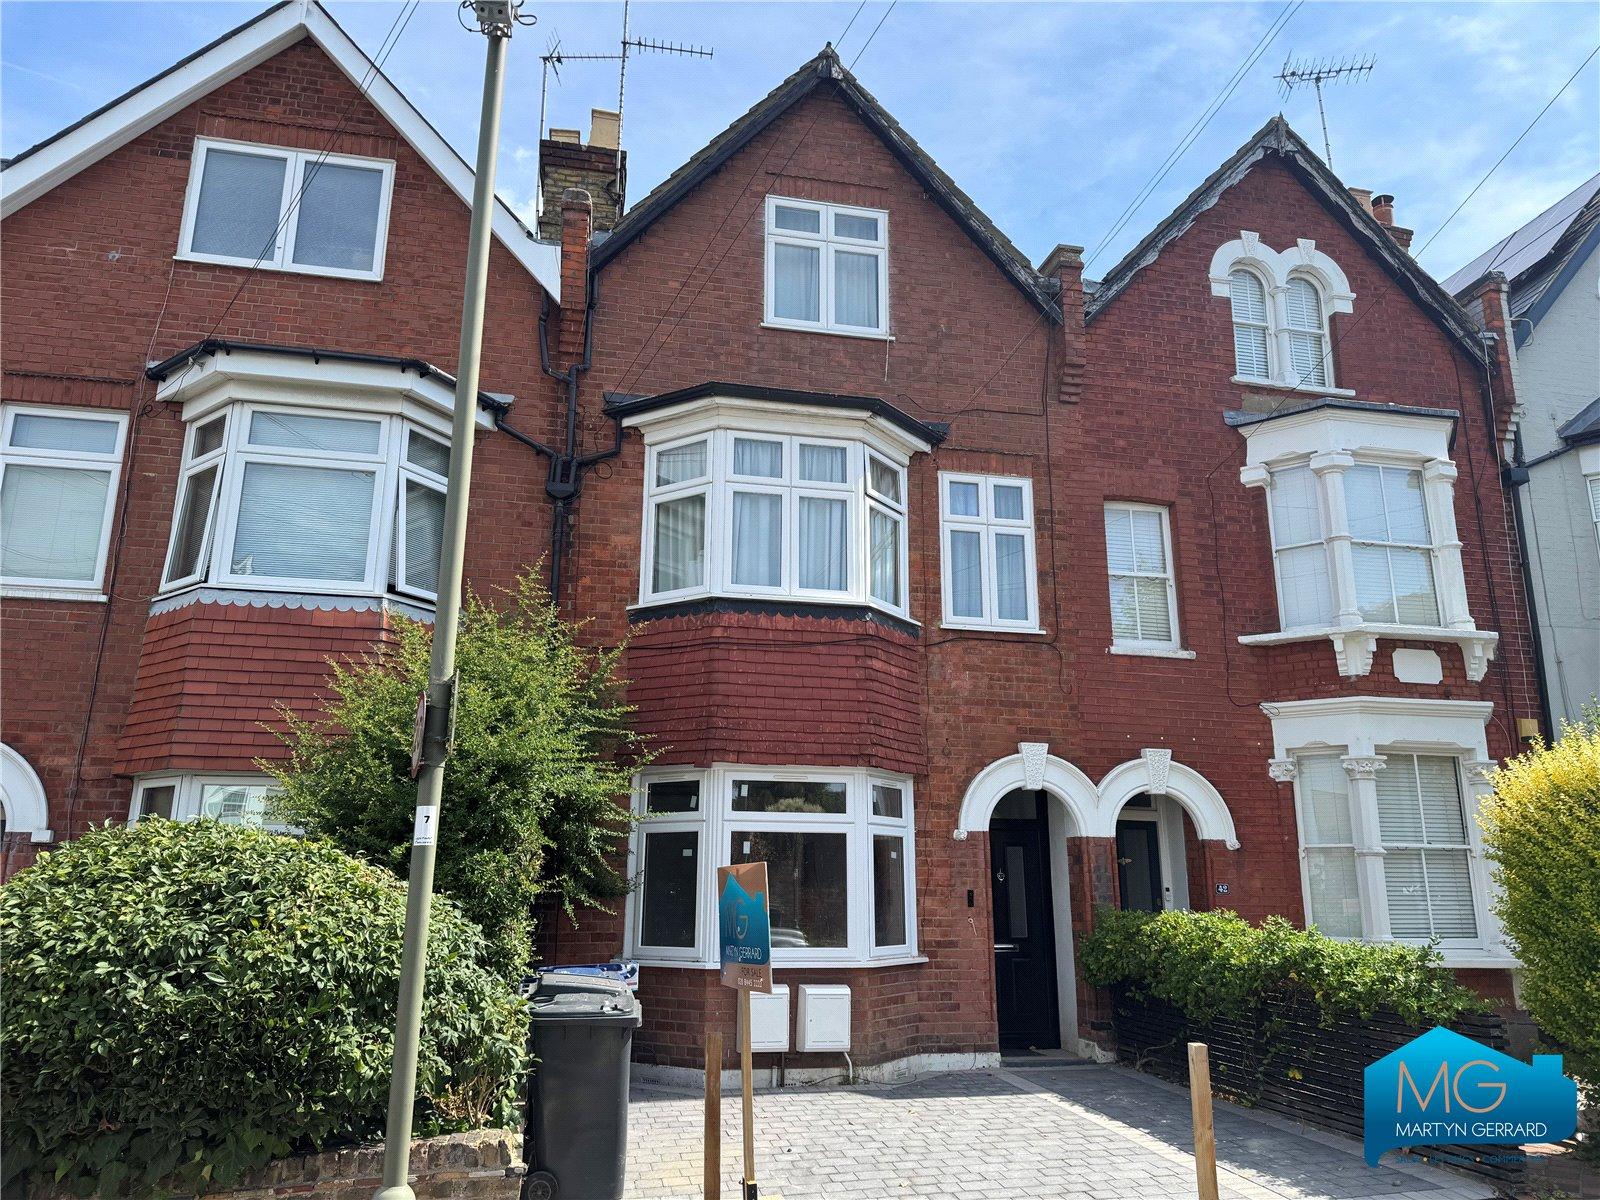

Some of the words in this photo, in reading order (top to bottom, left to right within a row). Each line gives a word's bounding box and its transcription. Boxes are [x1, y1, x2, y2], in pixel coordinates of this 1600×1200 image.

[1218, 885, 1229, 893] 42
[738, 946, 763, 960] GERRARD
[750, 968, 763, 979] SALE
